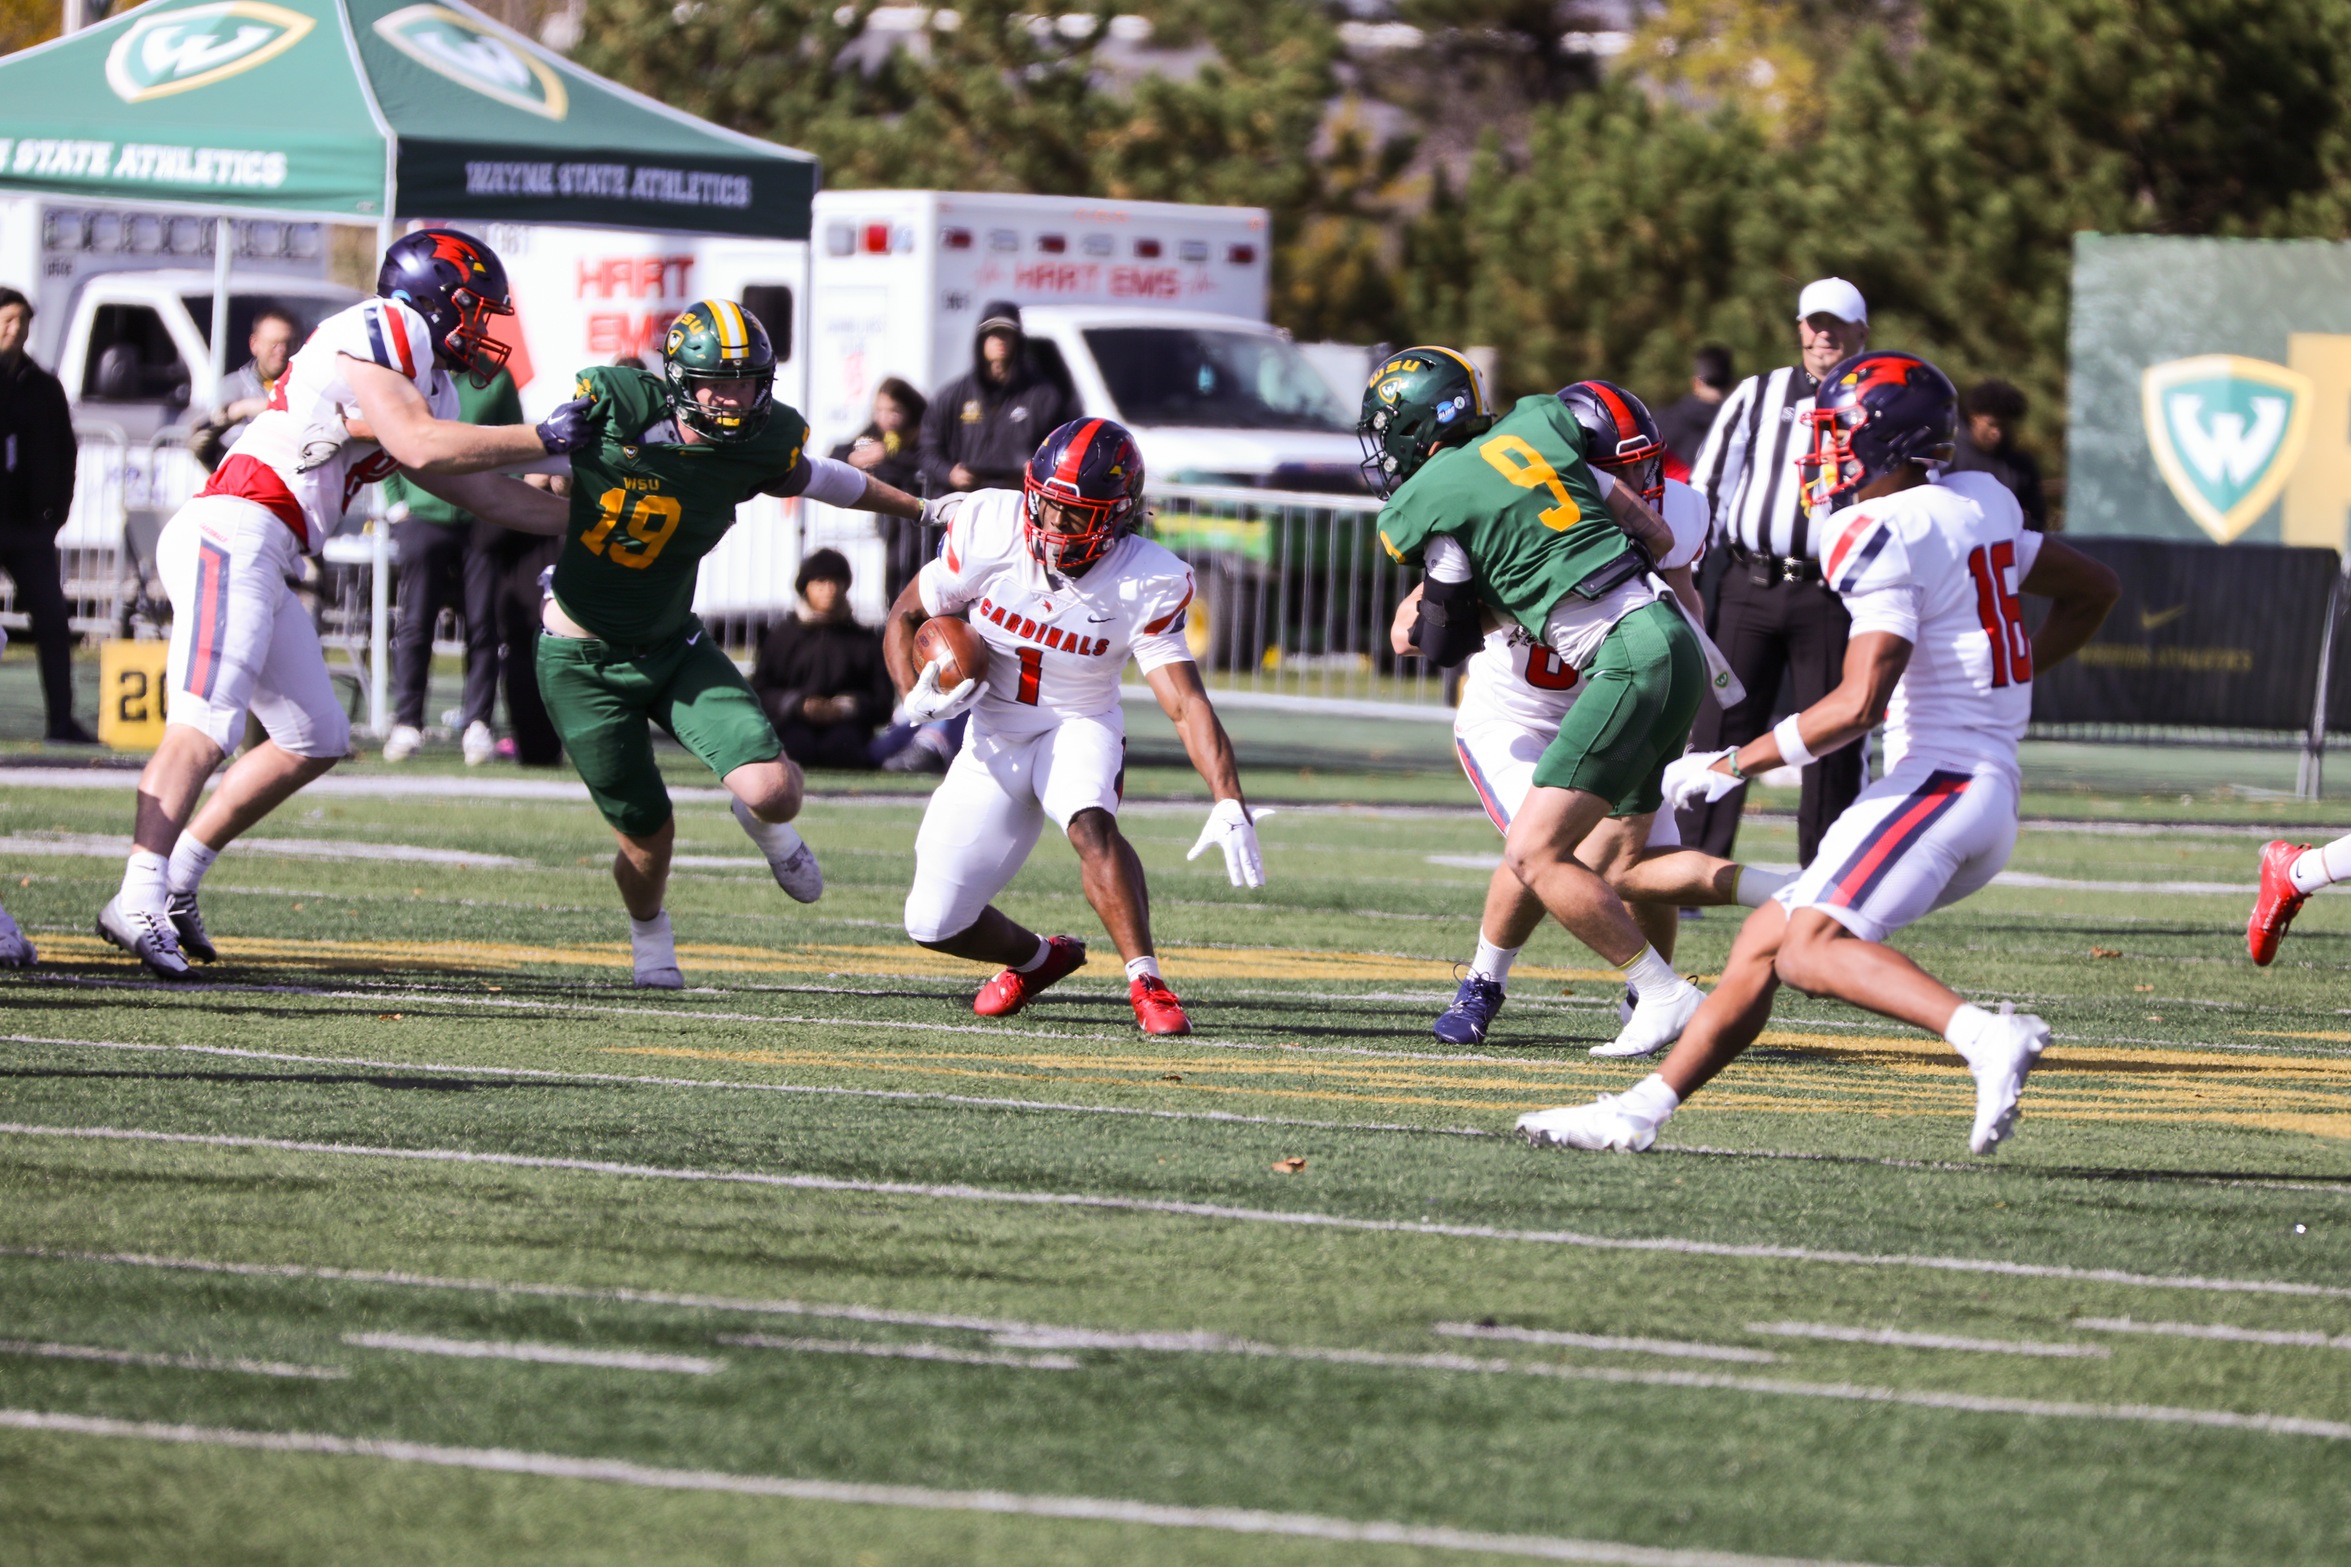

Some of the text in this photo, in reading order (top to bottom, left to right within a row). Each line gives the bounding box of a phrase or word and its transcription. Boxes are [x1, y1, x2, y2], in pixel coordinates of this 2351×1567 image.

[13, 138, 114, 177] STATE
[113, 143, 287, 188] ATHLETICS
[465, 160, 751, 206] WAYNE STATE ATHLETICS
[577, 257, 693, 299] HART
[1015, 262, 1180, 299] HART EMS
[1369, 359, 1421, 389] WSU
[2168, 392, 2288, 487] W
[623, 476, 660, 491] WSU
[1479, 434, 1581, 533] 9
[580, 487, 682, 570] 19
[980, 597, 1110, 657] CARDINALS
[1968, 538, 2032, 688] 16
[119, 671, 167, 722] 2
[1015, 646, 1044, 707] 1
